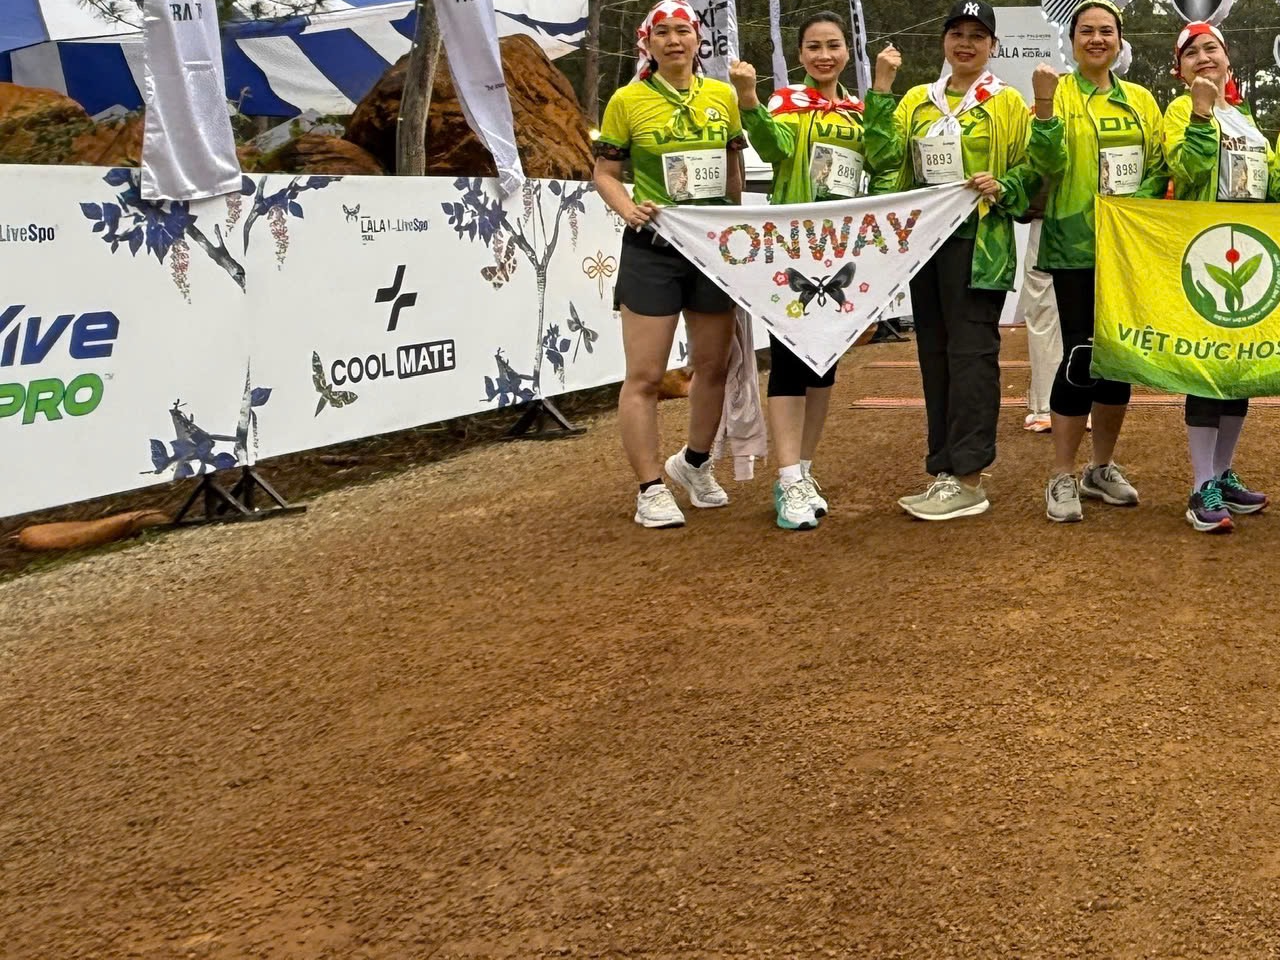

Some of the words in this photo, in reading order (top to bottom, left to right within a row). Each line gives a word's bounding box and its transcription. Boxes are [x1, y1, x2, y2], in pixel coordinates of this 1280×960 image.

[926, 152, 953, 166] 8893
[1116, 163, 1138, 177] 8983
[719, 209, 922, 265] ONWAY
[1118, 323, 1170, 356] VIỆT
[1175, 336, 1231, 360] ĐỨC
